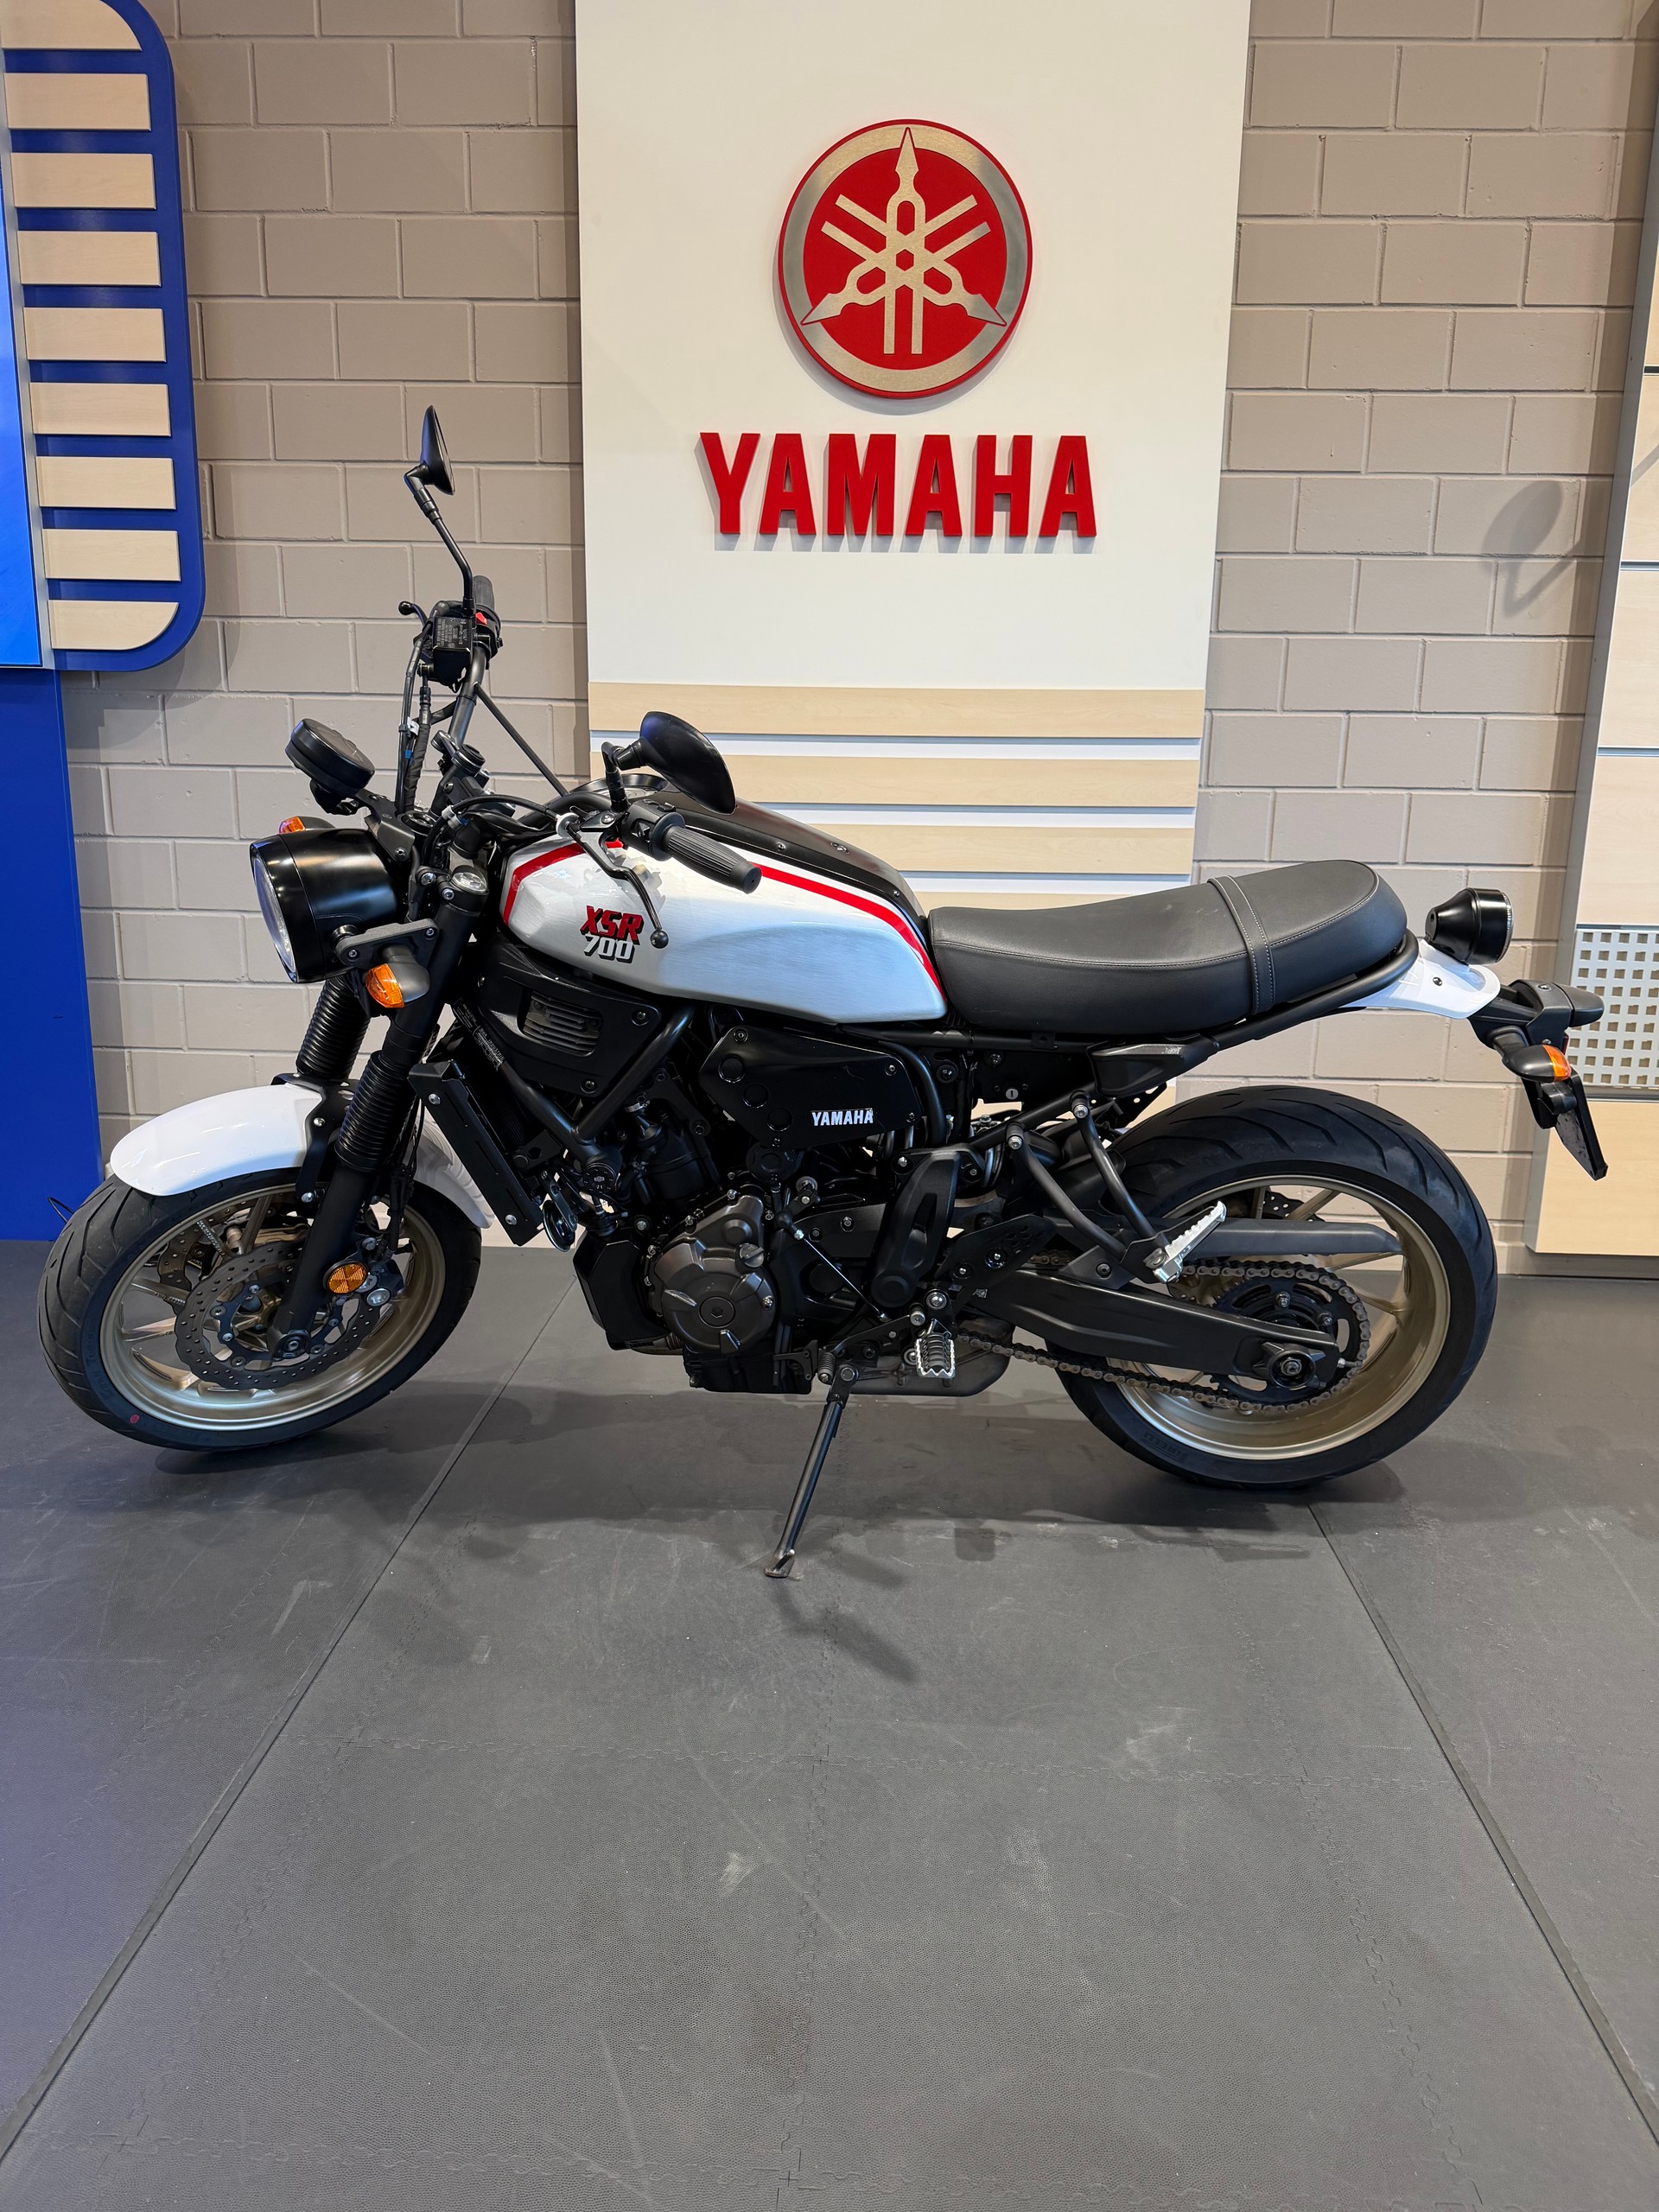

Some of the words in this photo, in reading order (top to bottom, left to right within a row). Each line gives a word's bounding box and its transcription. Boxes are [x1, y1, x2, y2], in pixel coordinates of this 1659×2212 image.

[700, 432, 1096, 537] YAMAHA
[580, 905, 644, 945] XSR
[583, 933, 635, 963] 700
[811, 1109, 874, 1126] YAMAHA
